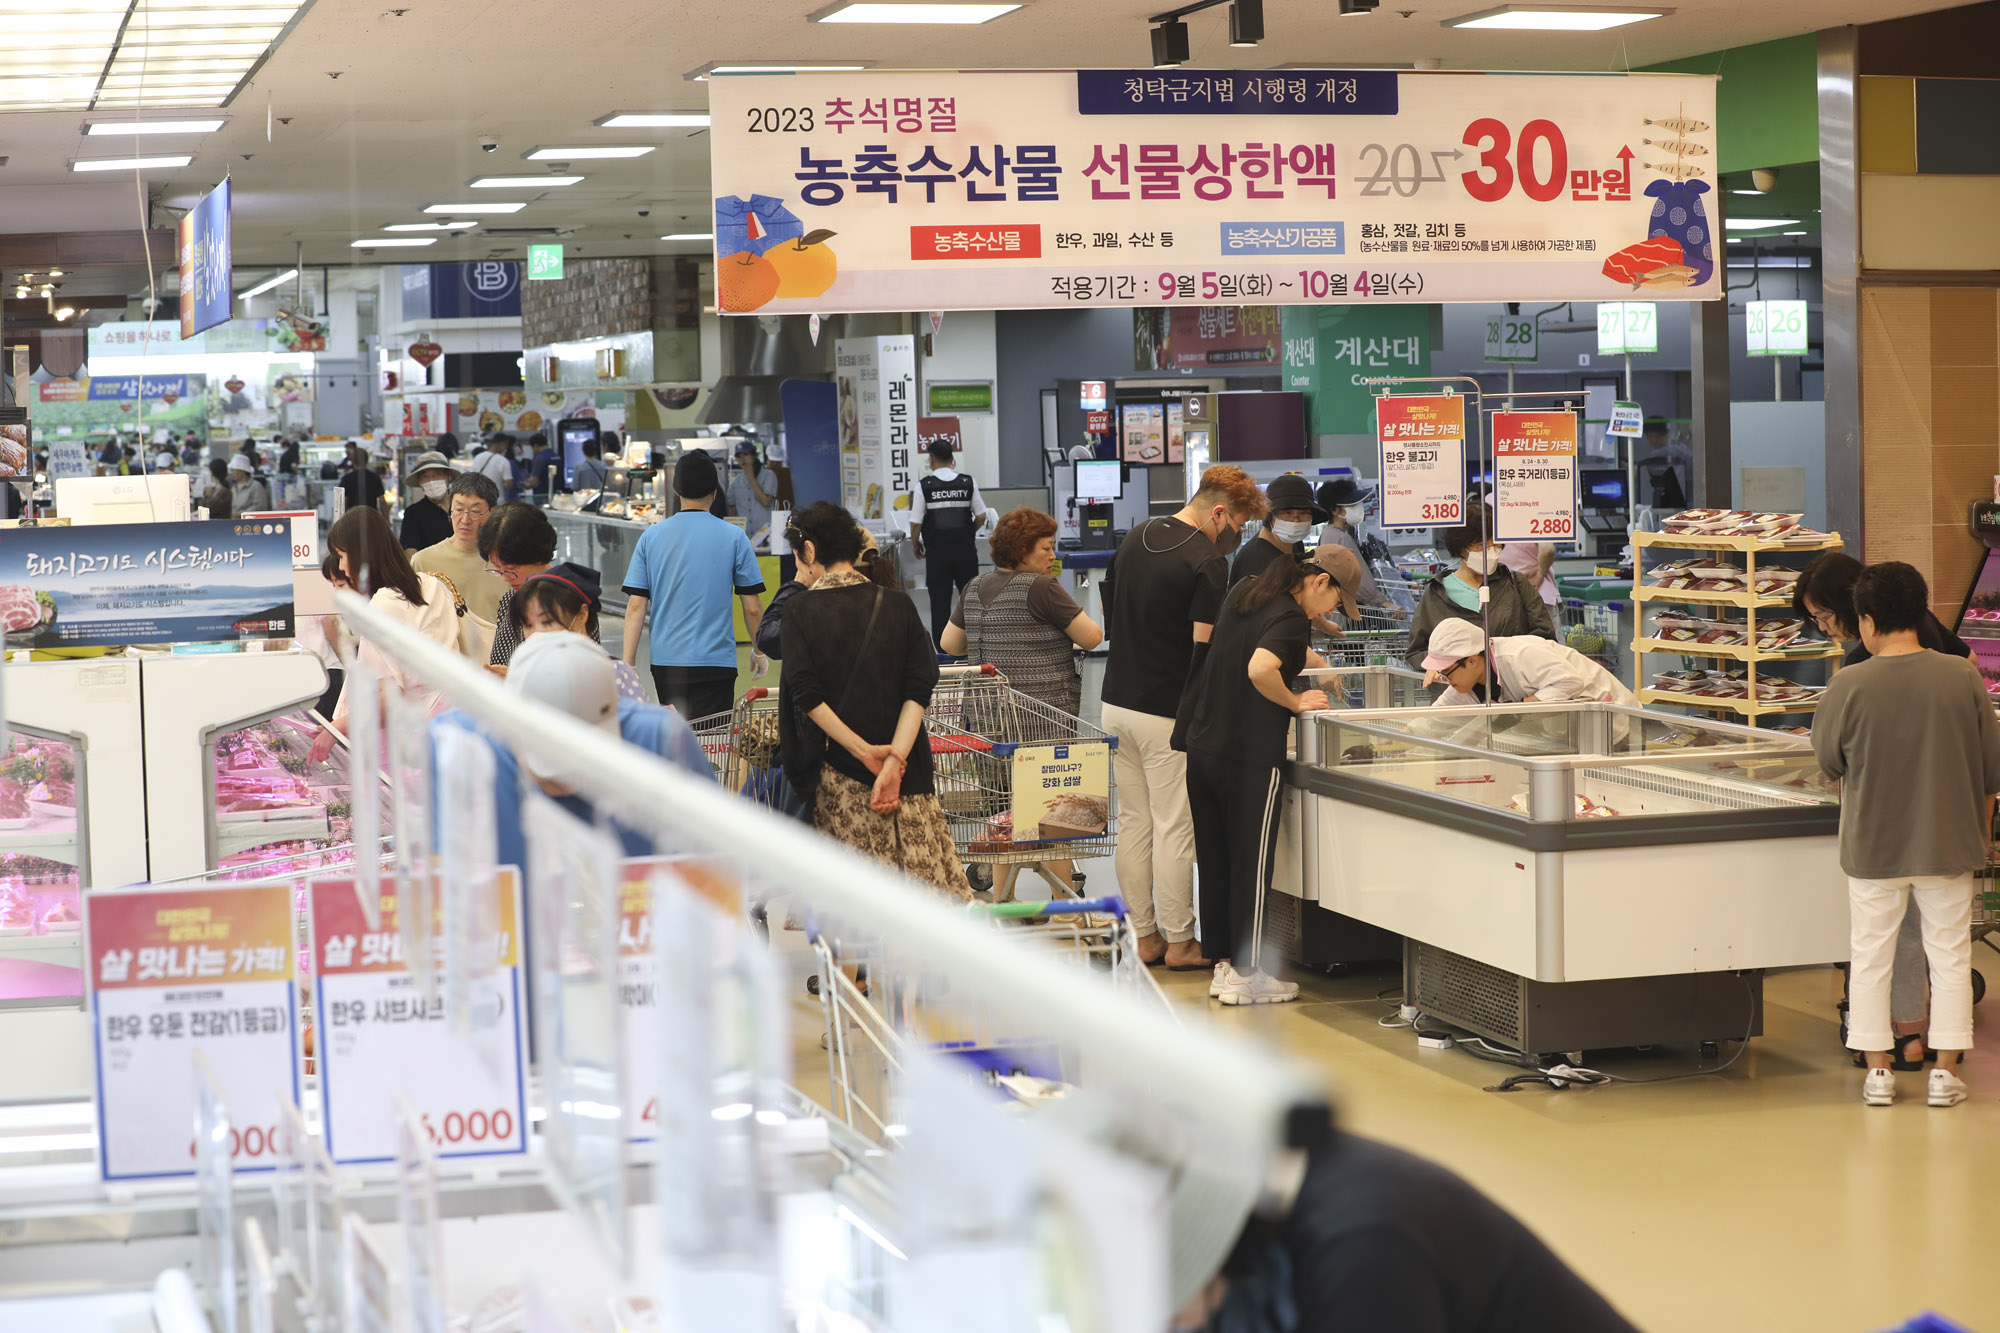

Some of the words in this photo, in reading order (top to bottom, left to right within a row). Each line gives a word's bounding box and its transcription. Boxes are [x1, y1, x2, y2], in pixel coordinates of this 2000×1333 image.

[1123, 77, 1233, 103] 청탁금지법
[1242, 77, 1307, 103] 시행령
[1315, 78, 1358, 103] 개정
[747, 107, 815, 134] 2023
[824, 97, 957, 134] 추석명절
[794, 144, 1062, 206] 농축수산물
[1081, 143, 1336, 201] 선물상한액
[1228, 228, 1337, 248] 농축수산가공품
[1361, 223, 1388, 238] 홍삼,
[1393, 223, 1420, 238] 젓갈,
[1425, 223, 1449, 238] 김치
[1454, 223, 1466, 237] 등
[934, 231, 1021, 253] 농축수산물
[1056, 232, 1086, 249] 한우,
[1092, 232, 1122, 248] 과일,
[1128, 232, 1155, 248] 수산
[1160, 232, 1174, 248] 등
[1360, 239, 1408, 253] (농수산물을
[1461, 239, 1489, 252] 50%를
[1491, 239, 1509, 252] 넘게
[1511, 239, 1546, 252] 사용하여
[1548, 239, 1575, 252] 가공한
[1576, 239, 1596, 252] 제품)
[1051, 275, 1136, 300] 적용기간
[1158, 272, 1196, 300] 9월
[1201, 271, 1273, 300] 5일(화)
[1299, 270, 1348, 299] 10월
[1353, 270, 1424, 299] 4일(수)
[1601, 311, 1620, 334] 27
[1628, 310, 1651, 333] 27
[1749, 309, 1764, 334] 26
[1771, 309, 1801, 333] 26
[1487, 322, 1499, 343] 28
[1505, 322, 1532, 344] 28
[1285, 337, 1315, 367] 계산대
[1335, 336, 1420, 367] 계산대
[1291, 375, 1310, 386] Counter
[1092, 385, 1101, 398] 6
[889, 381, 911, 491] 레몬라테라
[1384, 423, 1396, 437] 살
[1399, 422, 1435, 436] 맛나는
[1438, 422, 1460, 435] 가격!
[1498, 438, 1511, 452] 살
[1513, 438, 1549, 452] 맛나는
[1551, 439, 1573, 451] 가격!
[1386, 452, 1405, 462] 한우
[1408, 451, 1438, 462] 불고기
[1499, 469, 1515, 479] 한우
[1518, 468, 1570, 480] 국거리(1등급)
[931, 490, 968, 499] SECURITY
[1422, 503, 1459, 519] 3,180
[1530, 519, 1571, 535] 2,880
[26, 551, 138, 578] 돼지고기도
[144, 546, 254, 574] 시스템이다
[113, 601, 145, 609] 돼지고기도
[268, 620, 286, 631] 한돈
[1042, 777, 1060, 788] 강화
[1063, 776, 1082, 787] 섬쌀
[323, 933, 357, 968] 살
[101, 949, 133, 982] 살
[137, 945, 226, 979] 맛나는
[230, 943, 286, 973] 가격!
[107, 1014, 142, 1042] 한우
